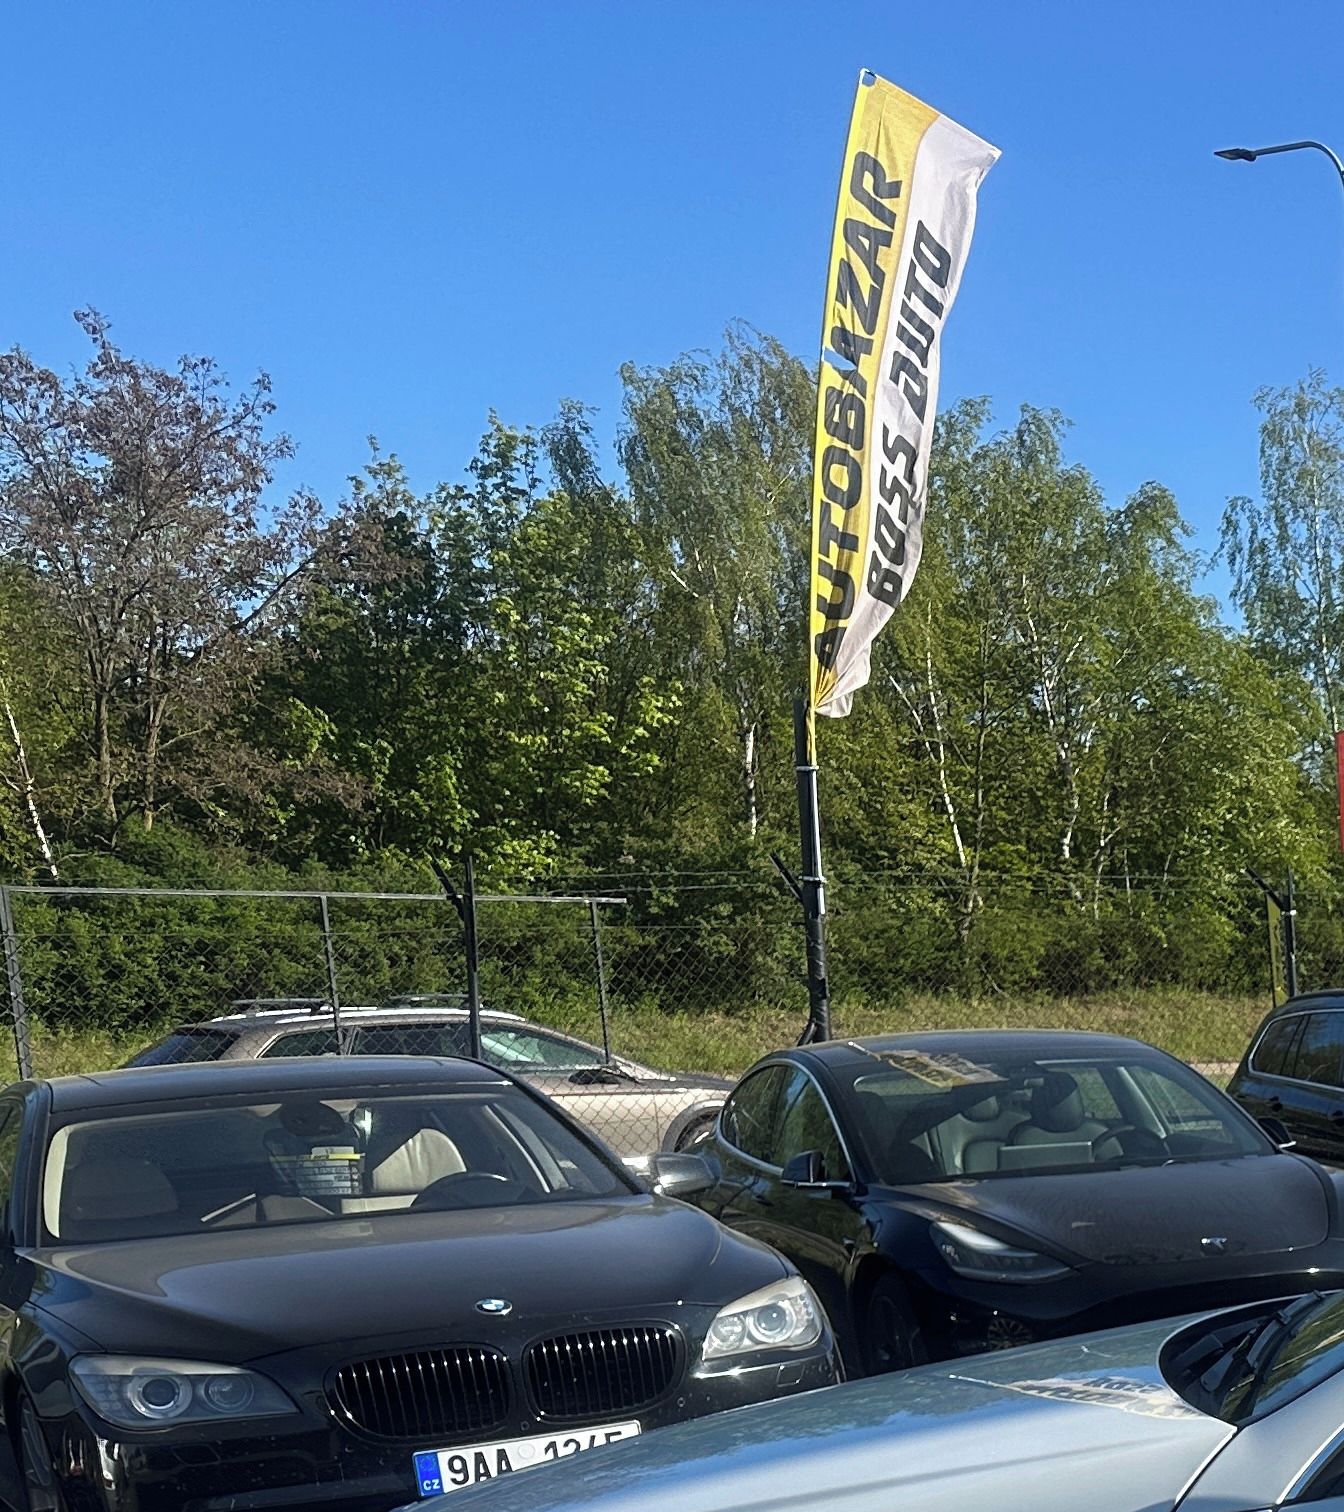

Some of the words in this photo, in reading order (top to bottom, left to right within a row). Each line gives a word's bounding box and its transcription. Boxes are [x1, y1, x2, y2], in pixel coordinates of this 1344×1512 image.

[814, 149, 903, 672] AUTOBAZAR
[889, 219, 953, 425] AUTO
[867, 421, 917, 608] BOSS
[422, 1478, 441, 1491] CZ
[447, 1448, 514, 1486] 9AA
